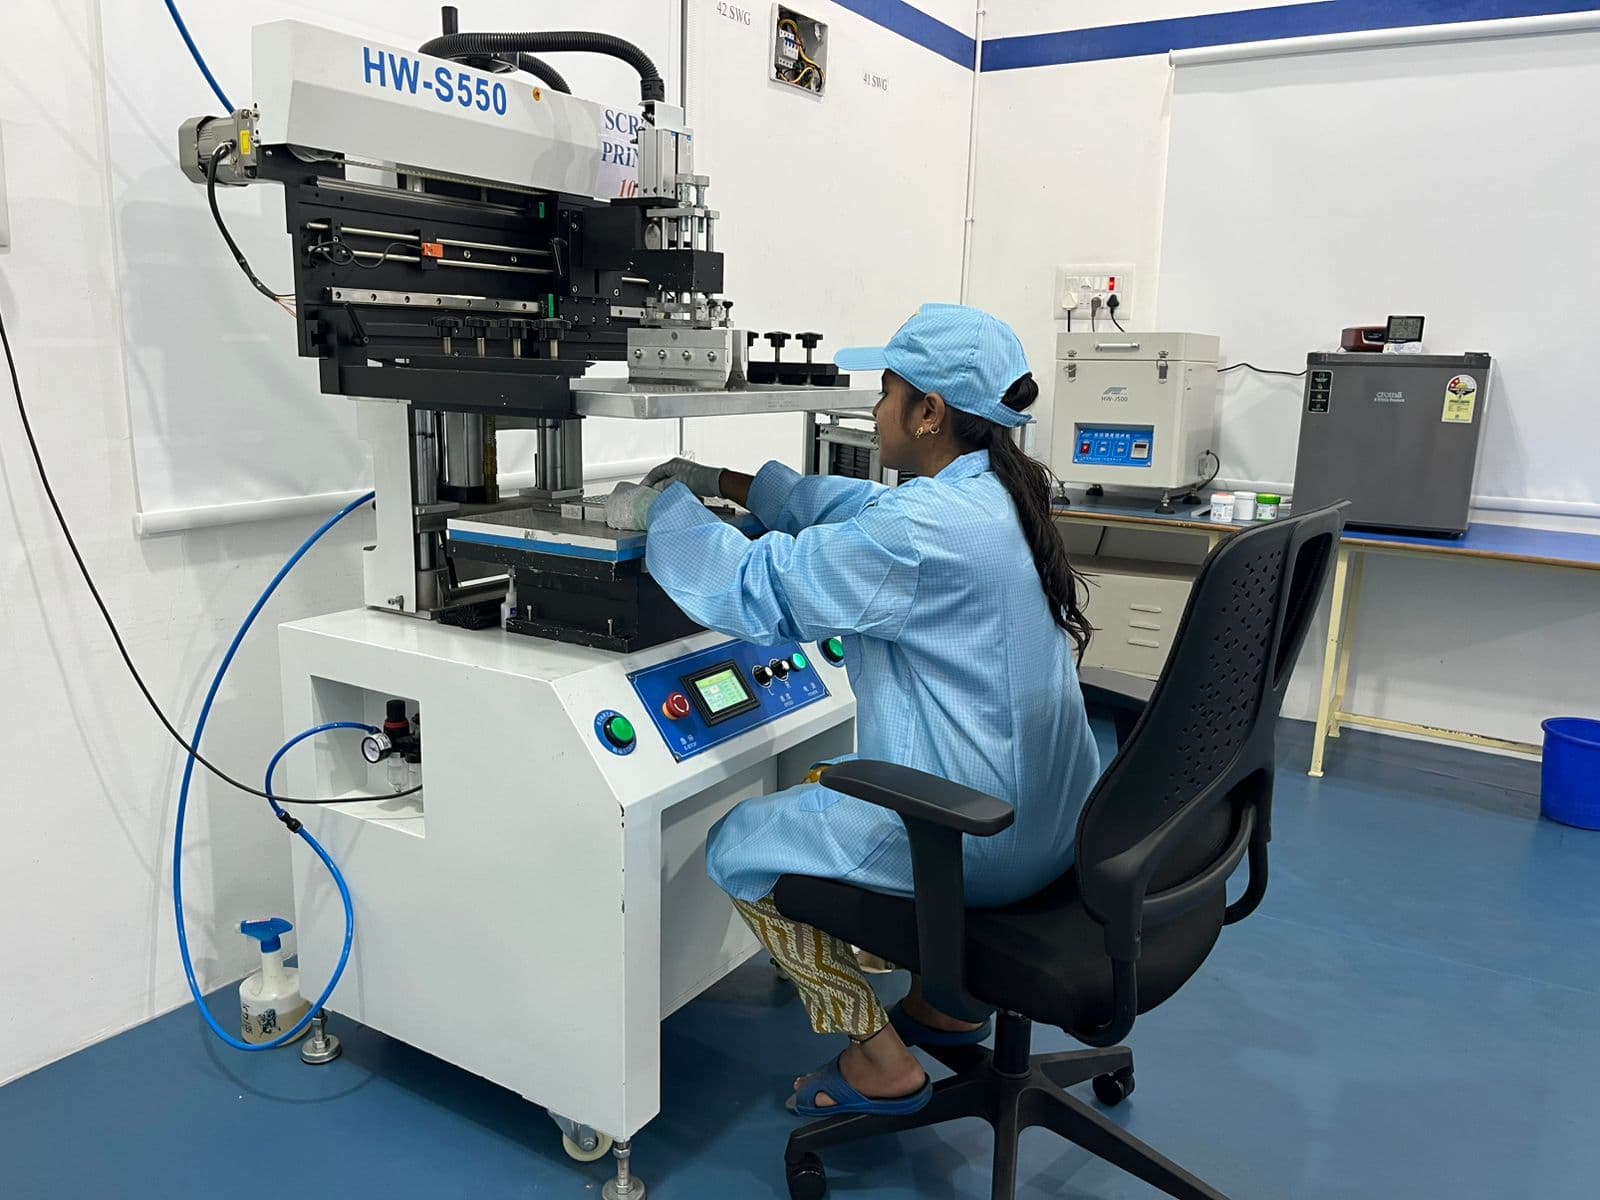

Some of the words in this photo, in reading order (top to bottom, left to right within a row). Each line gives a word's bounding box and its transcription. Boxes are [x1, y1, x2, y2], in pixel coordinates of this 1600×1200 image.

[716, 1, 728, 17] 42
[729, 5, 751, 26] SWG
[363, 46, 507, 116] HW-S550
[605, 109, 641, 136] SCR
